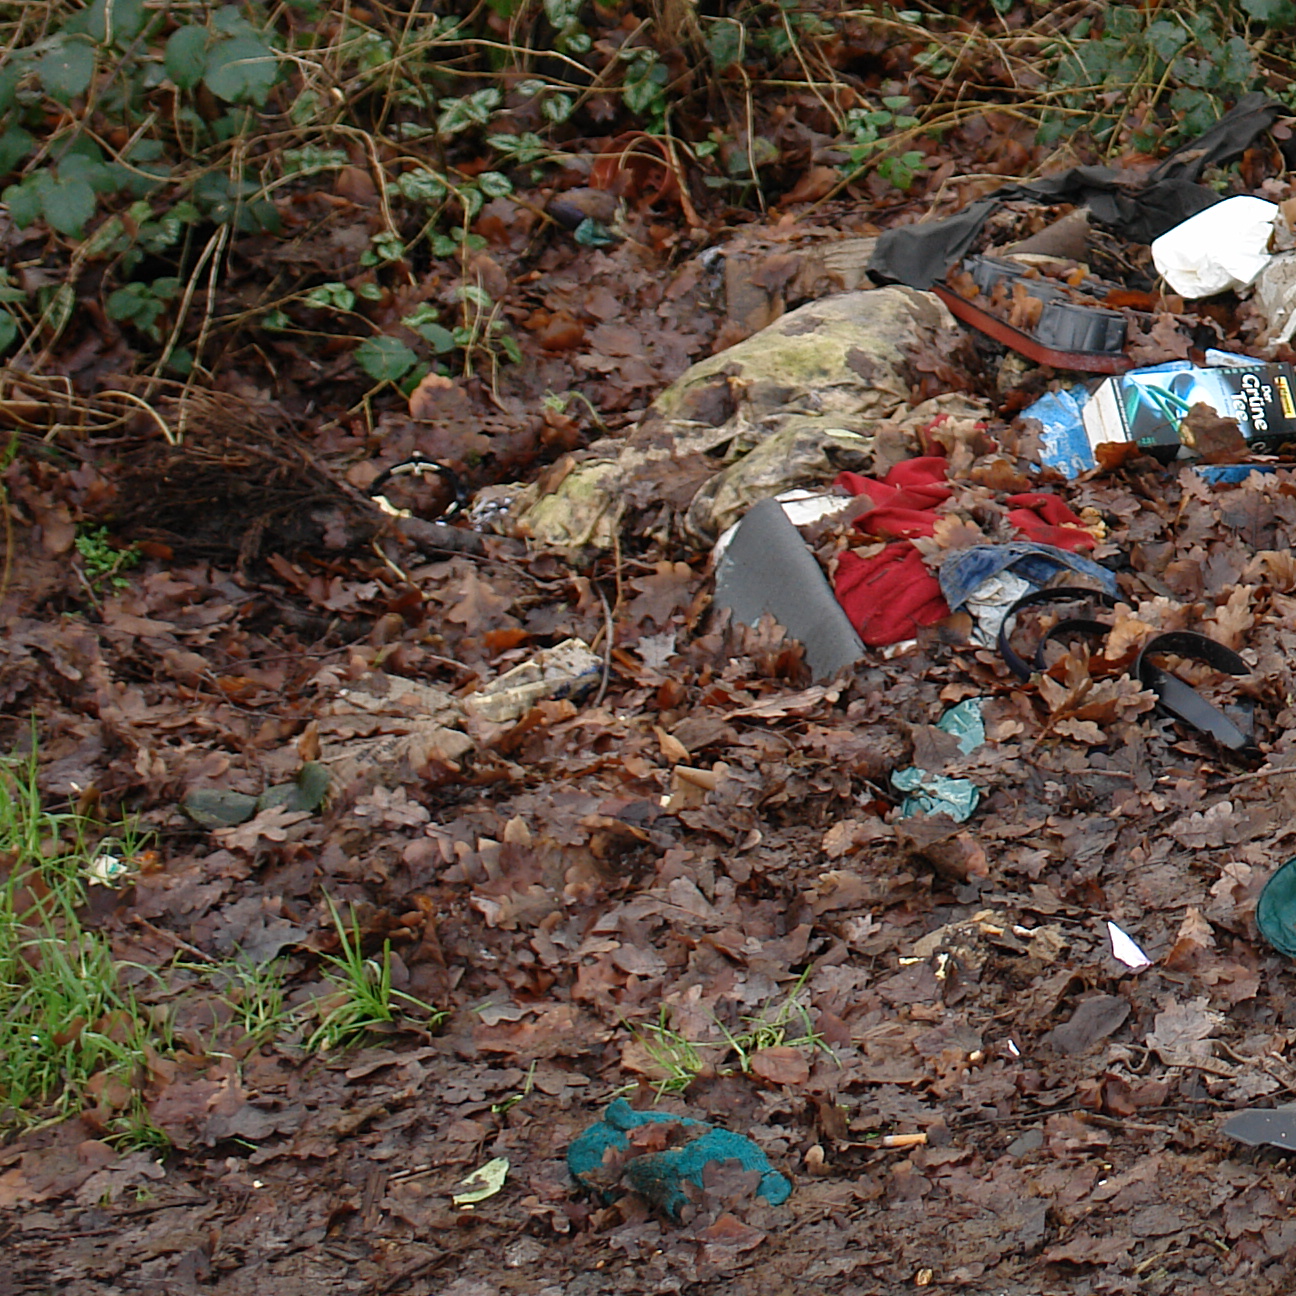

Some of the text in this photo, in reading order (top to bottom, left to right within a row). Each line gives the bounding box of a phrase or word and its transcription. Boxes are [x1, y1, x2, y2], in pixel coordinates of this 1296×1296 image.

[1230, 390, 1249, 422] Tee
[1241, 373, 1269, 431] Grüne
[1261, 384, 1273, 403] Der
